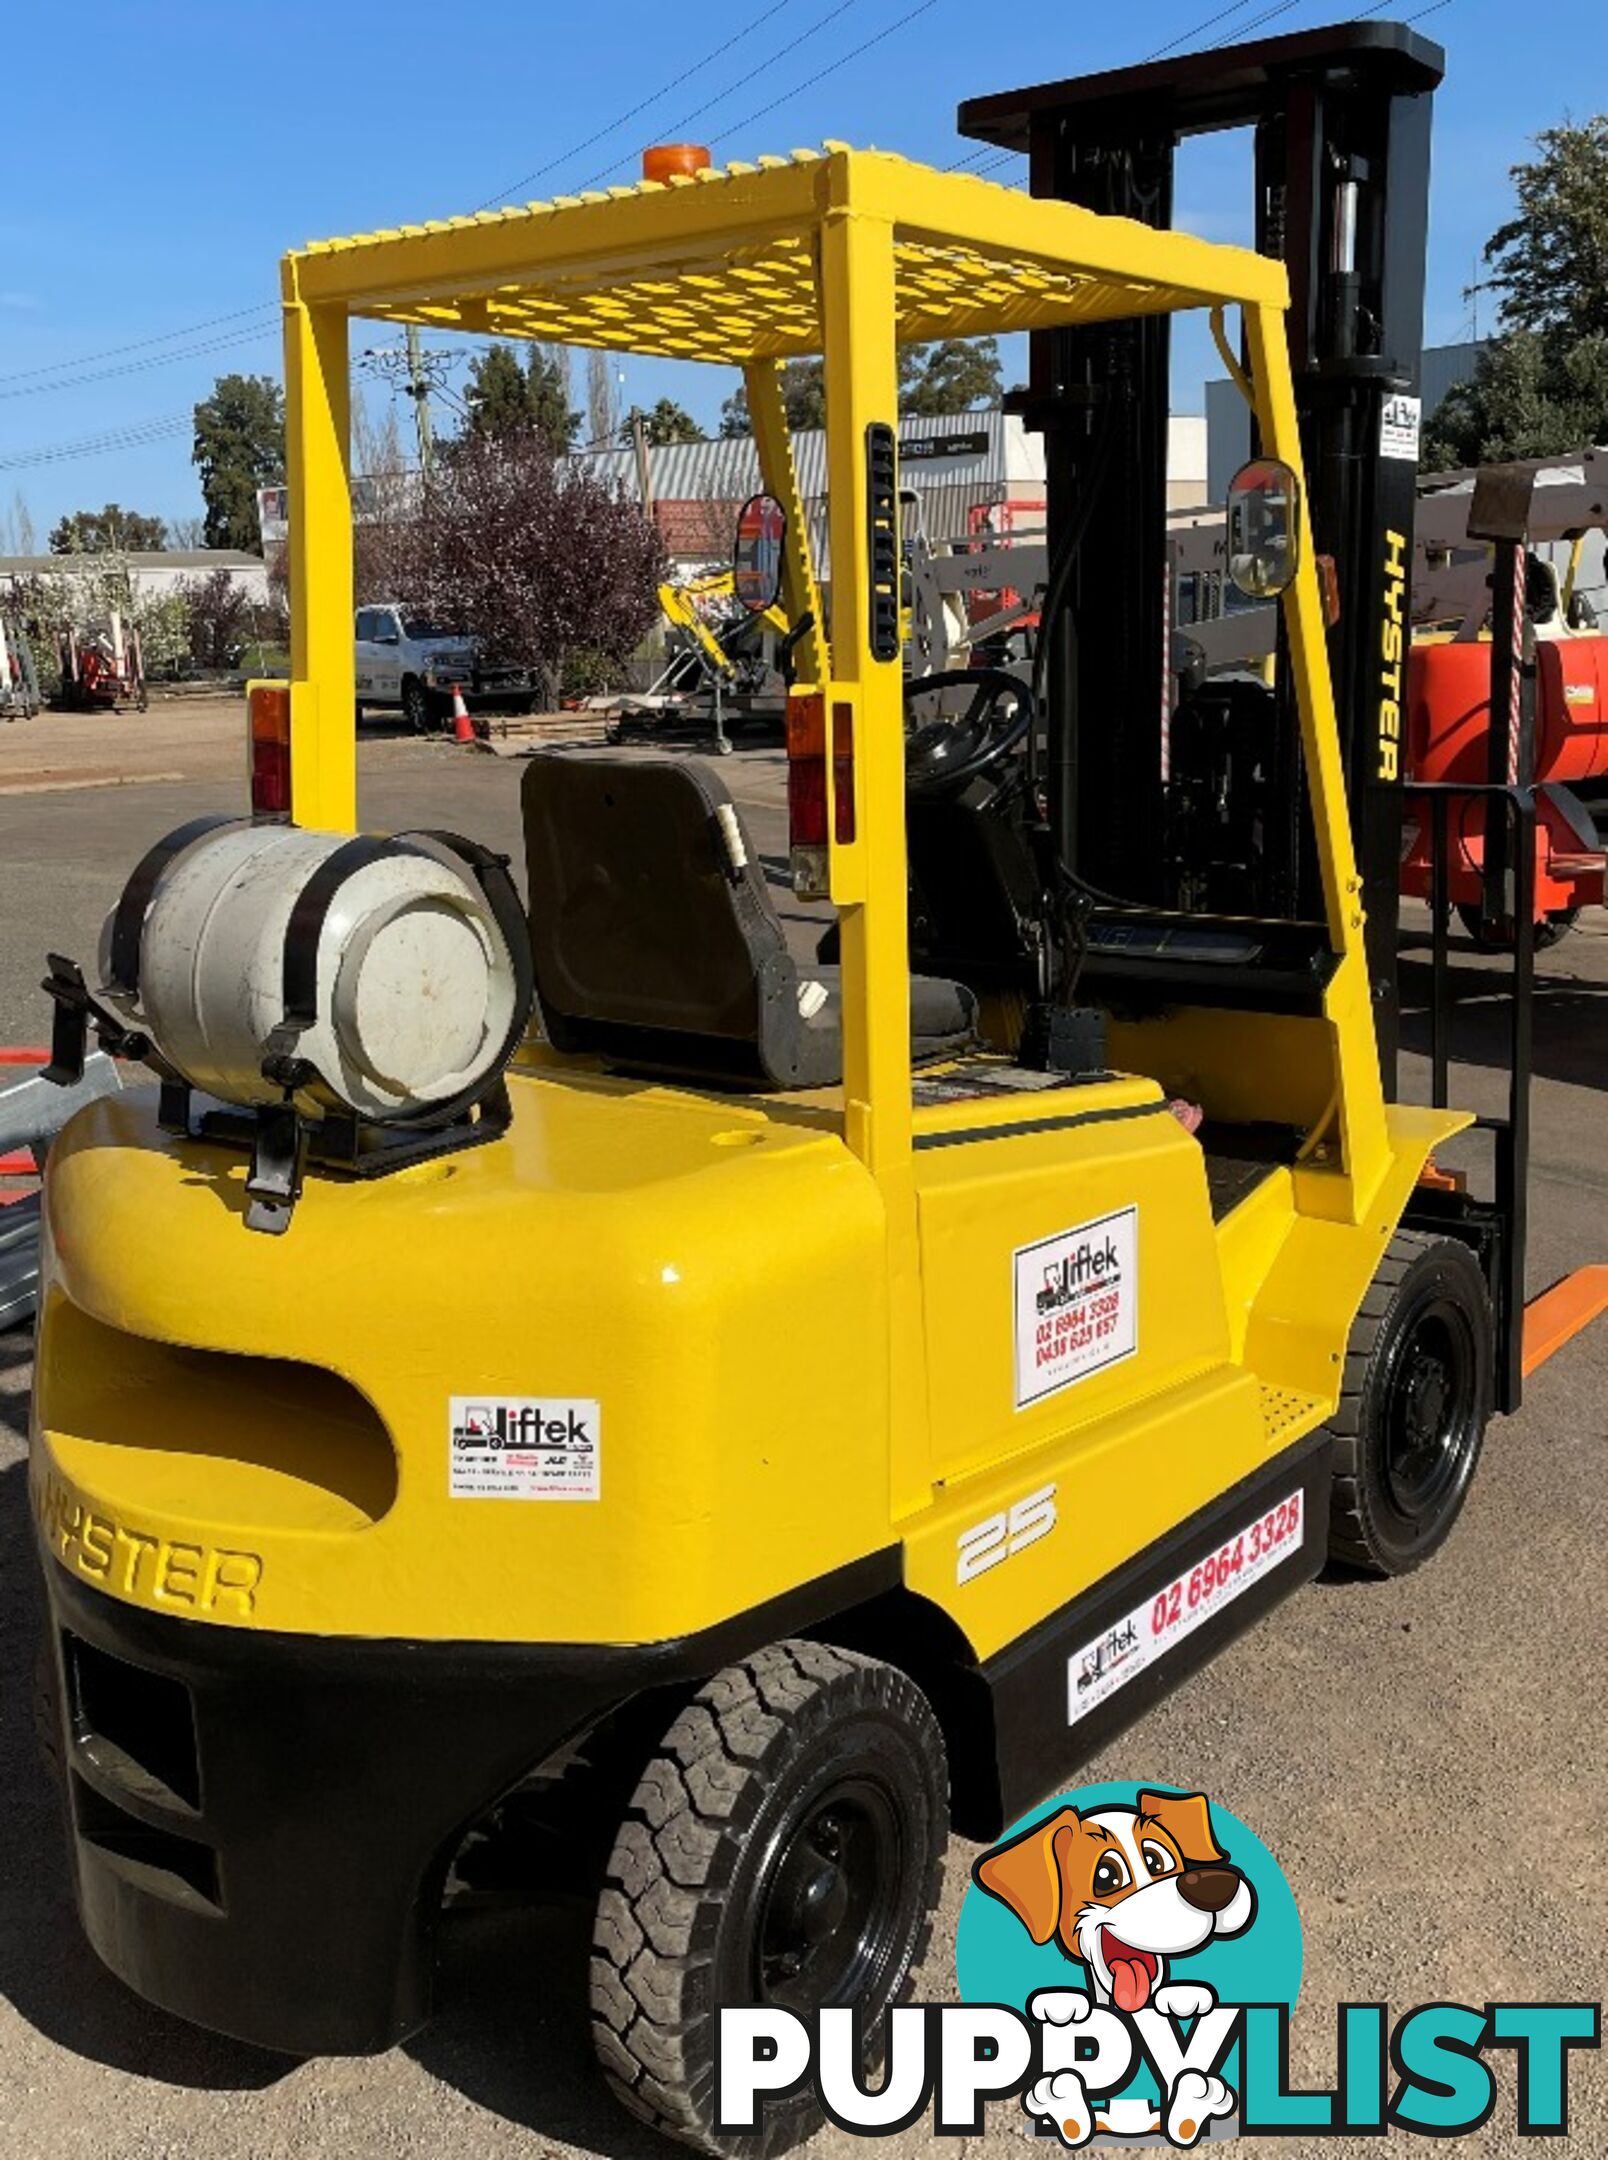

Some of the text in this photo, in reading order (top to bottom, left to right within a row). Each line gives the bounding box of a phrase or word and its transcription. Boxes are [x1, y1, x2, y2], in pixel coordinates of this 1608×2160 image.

[1378, 529, 1407, 782] HYSTER
[1036, 1319, 1052, 1346] 02
[42, 1475, 263, 1617] HYSTER
[956, 1482, 1058, 1587] 25
[1151, 1494, 1300, 1636] 02 6964 3328
